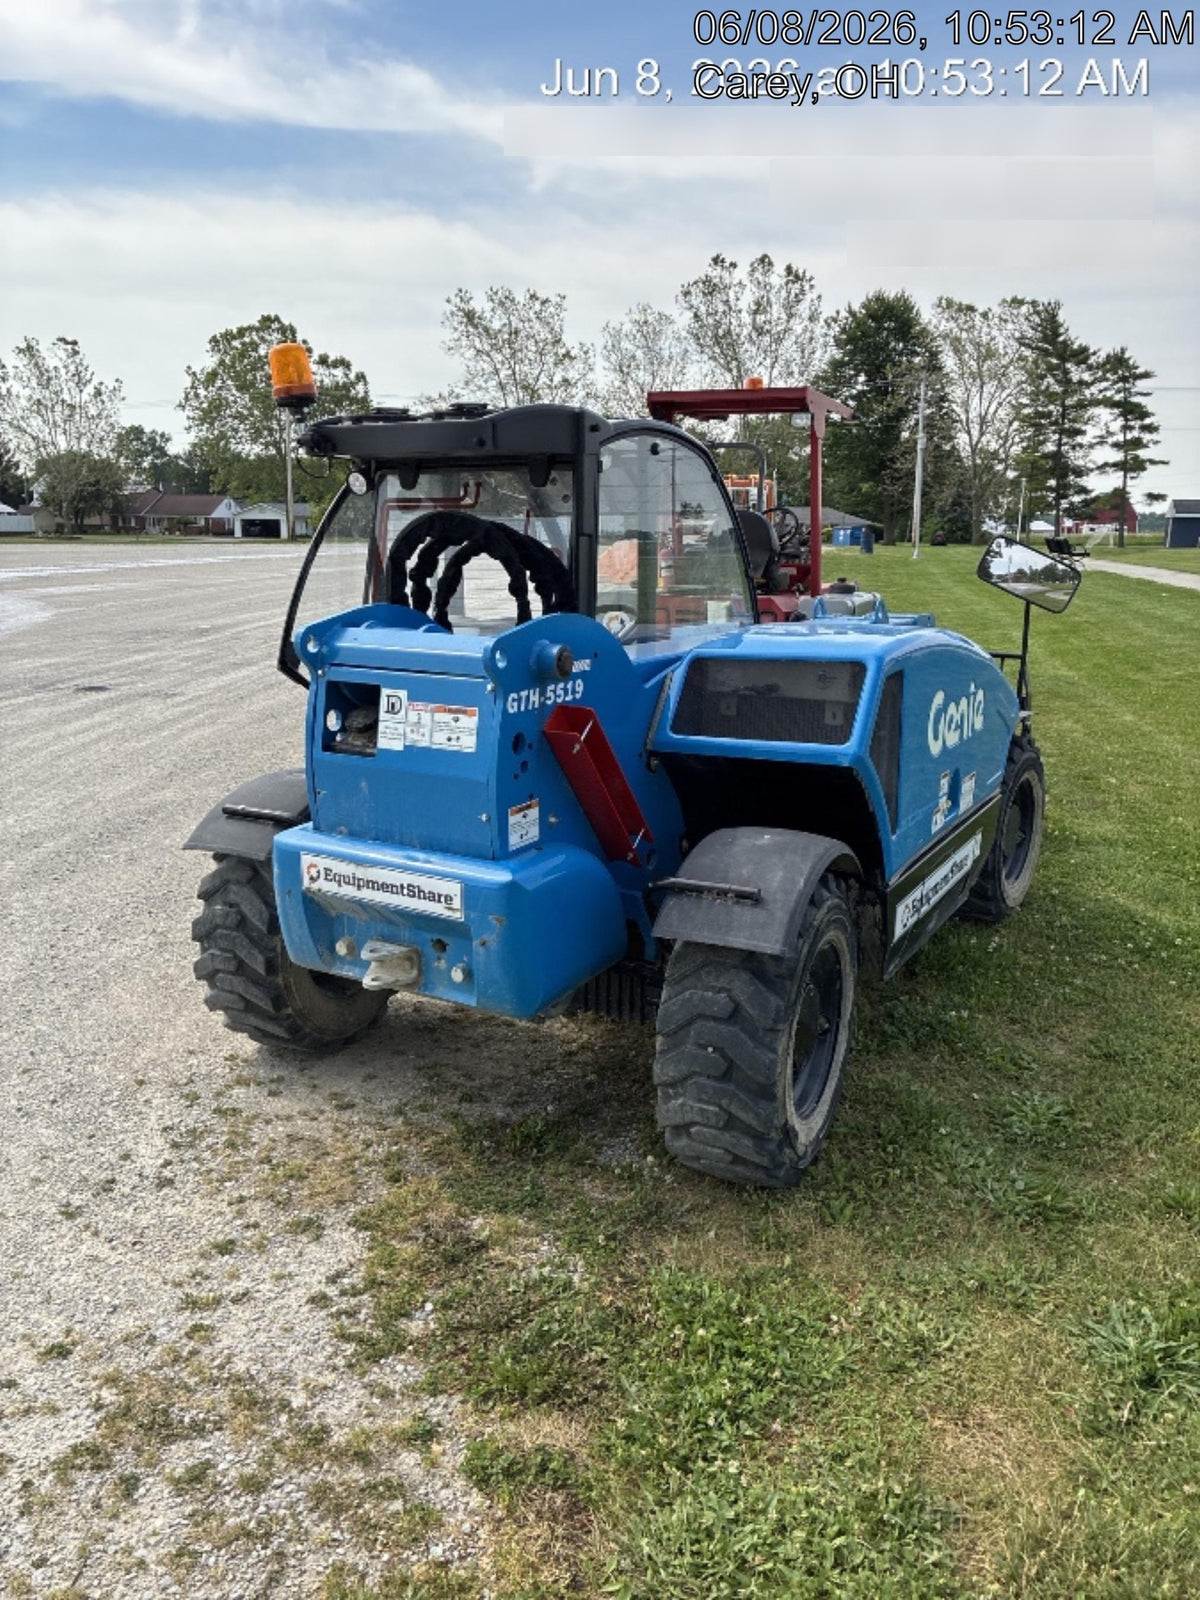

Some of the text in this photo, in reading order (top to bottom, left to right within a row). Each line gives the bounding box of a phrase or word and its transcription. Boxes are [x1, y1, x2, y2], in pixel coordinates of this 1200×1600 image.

[506, 679, 584, 714] GTH-5519
[928, 680, 984, 758] Genie
[323, 867, 454, 906] EquipmentShare
